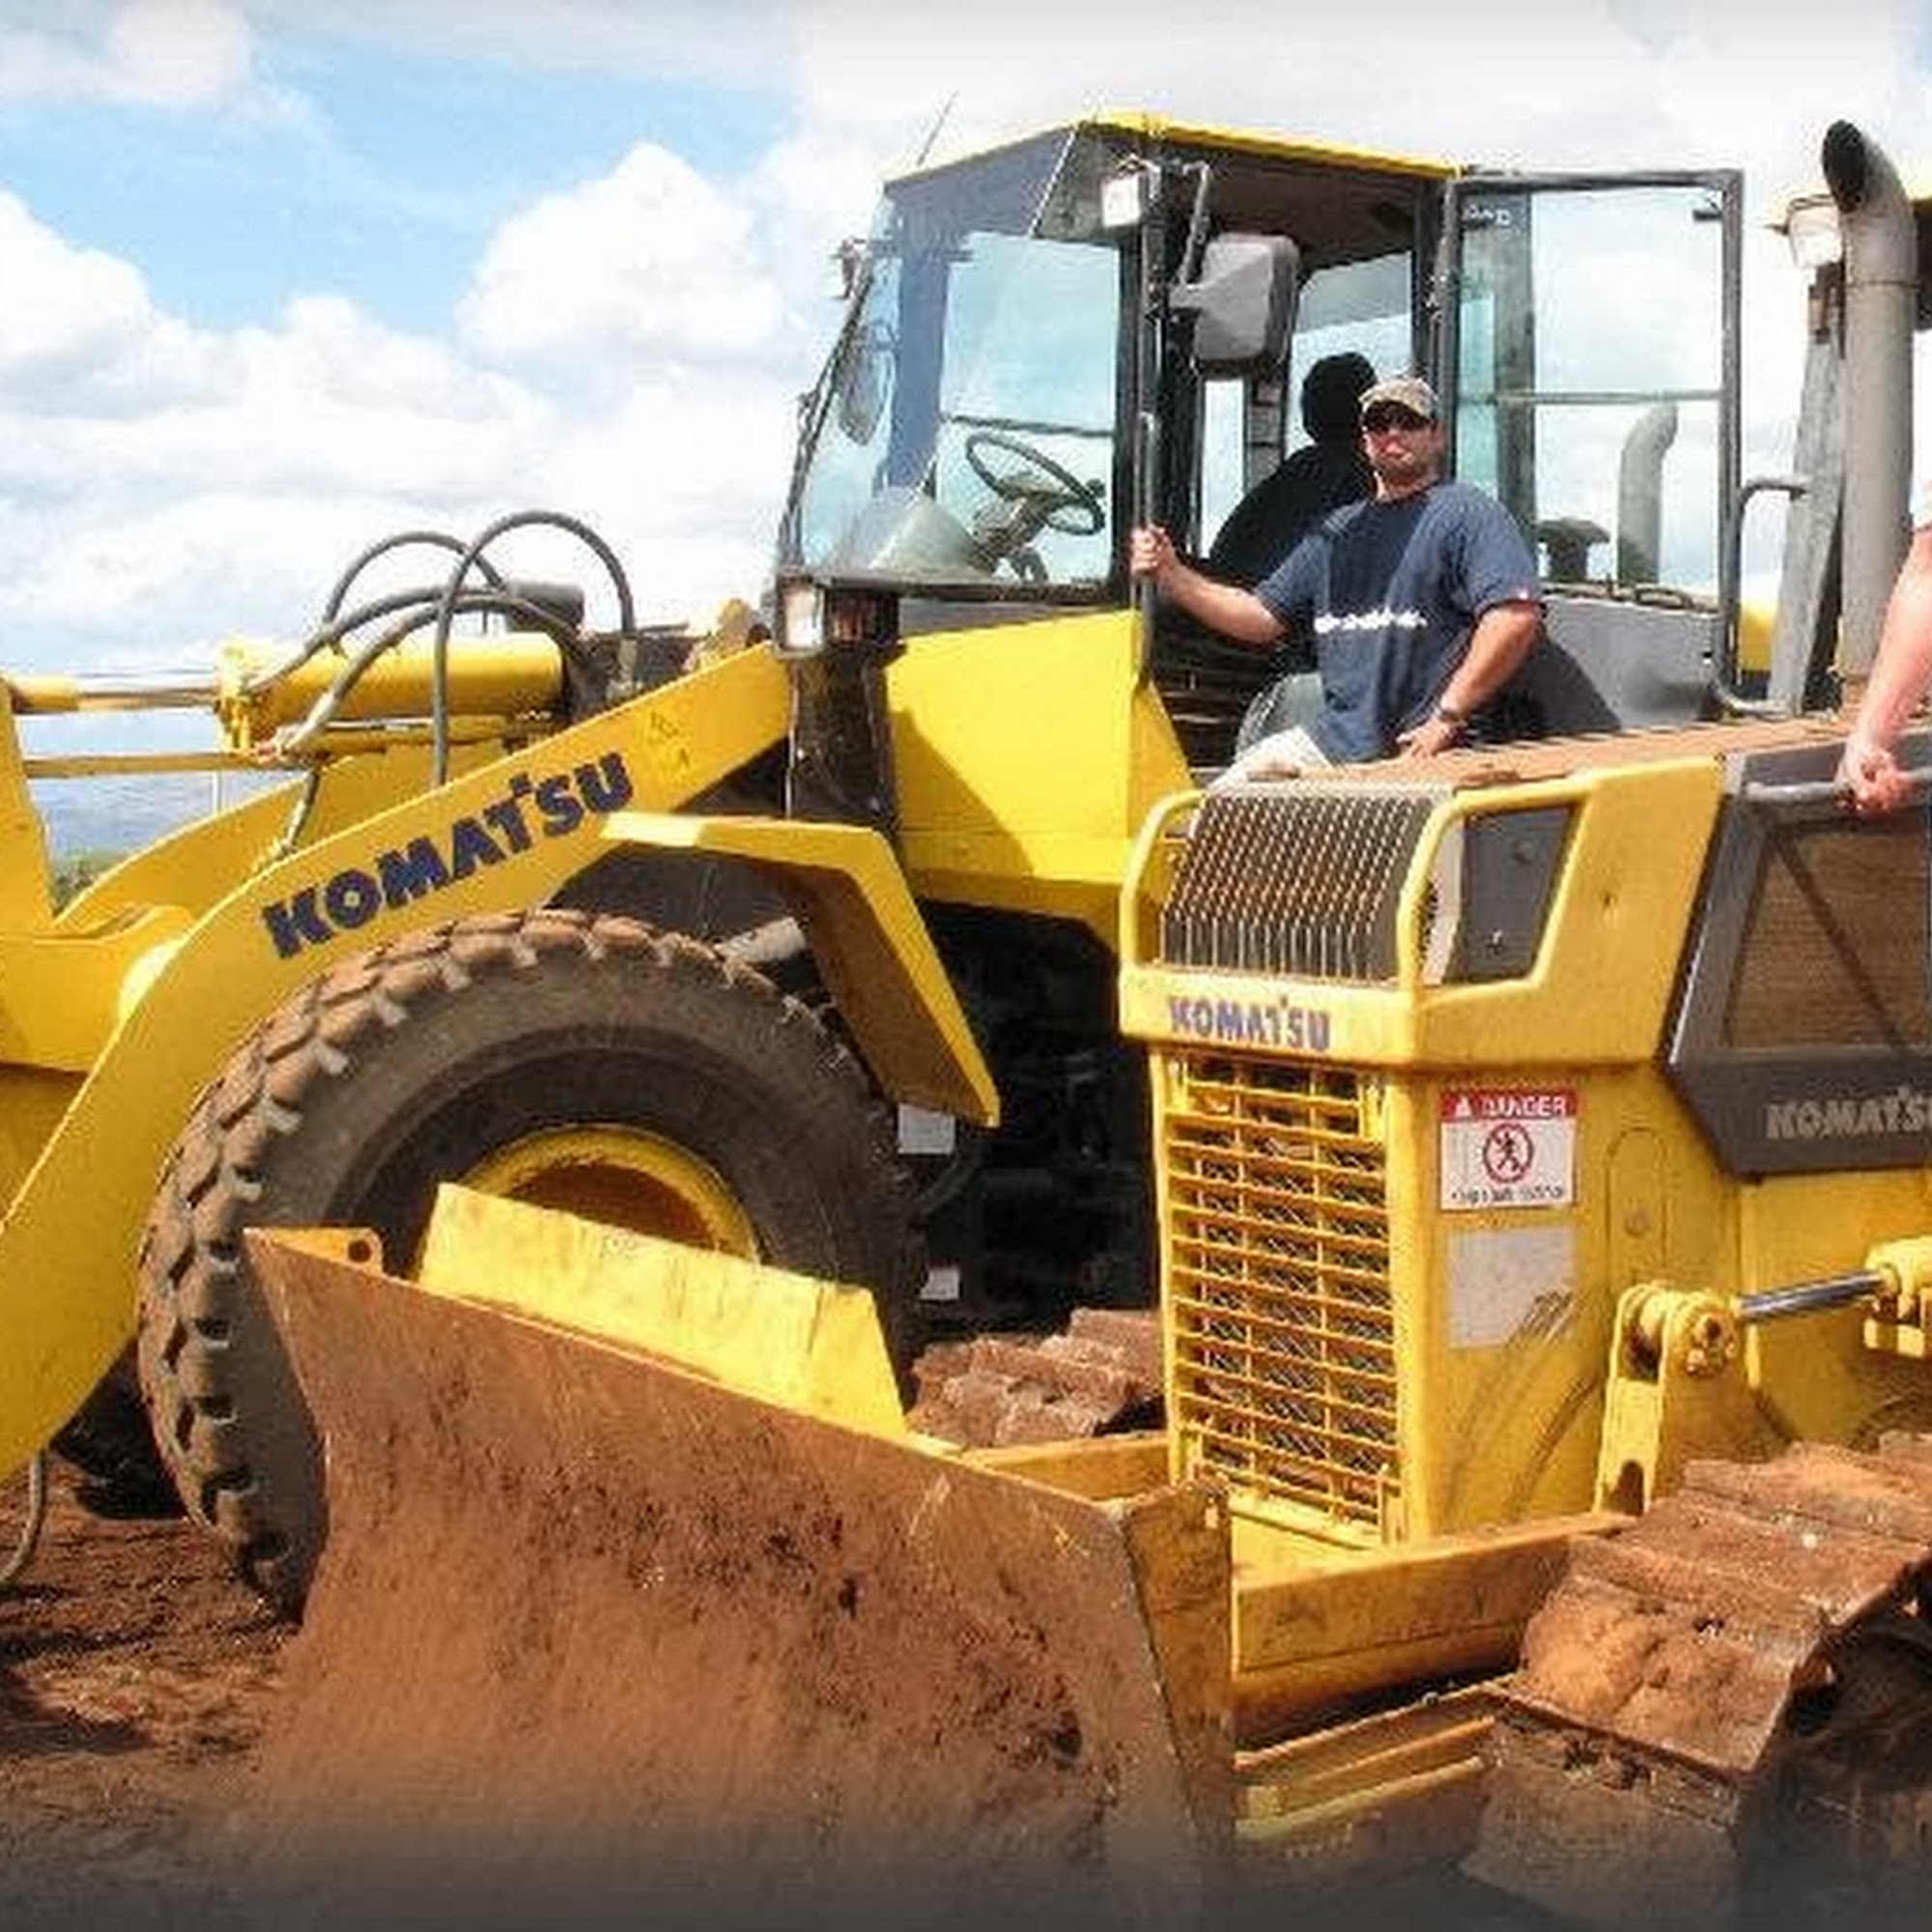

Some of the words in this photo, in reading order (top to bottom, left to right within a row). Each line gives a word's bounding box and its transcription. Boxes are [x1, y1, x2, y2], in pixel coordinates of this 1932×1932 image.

[262, 753, 634, 959] KOMATSU
[1169, 995, 1330, 1052] KOMATSU
[1481, 1094, 1567, 1119] DANGER
[1766, 1087, 1932, 1140] KOMATS
